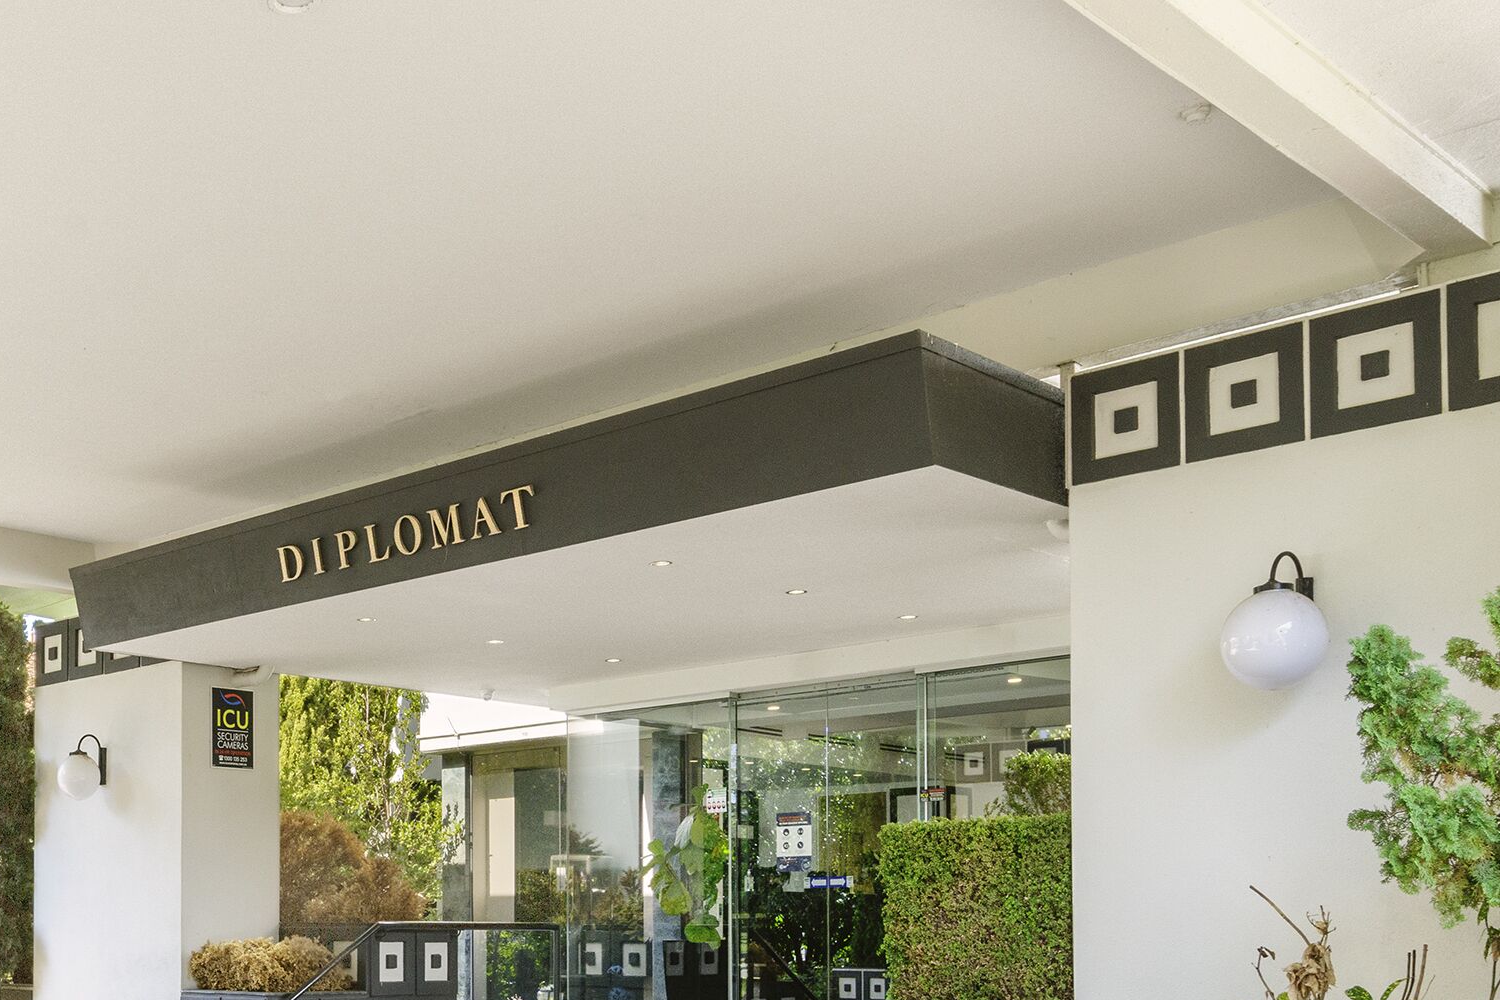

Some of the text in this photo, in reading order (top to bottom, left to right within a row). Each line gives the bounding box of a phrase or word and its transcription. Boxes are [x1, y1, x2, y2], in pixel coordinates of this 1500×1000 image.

[276, 483, 536, 583] DIPLOMAT
[217, 709, 249, 730] ICU
[217, 732, 249, 742] SECURITY
[217, 740, 249, 750] CAMERAS
